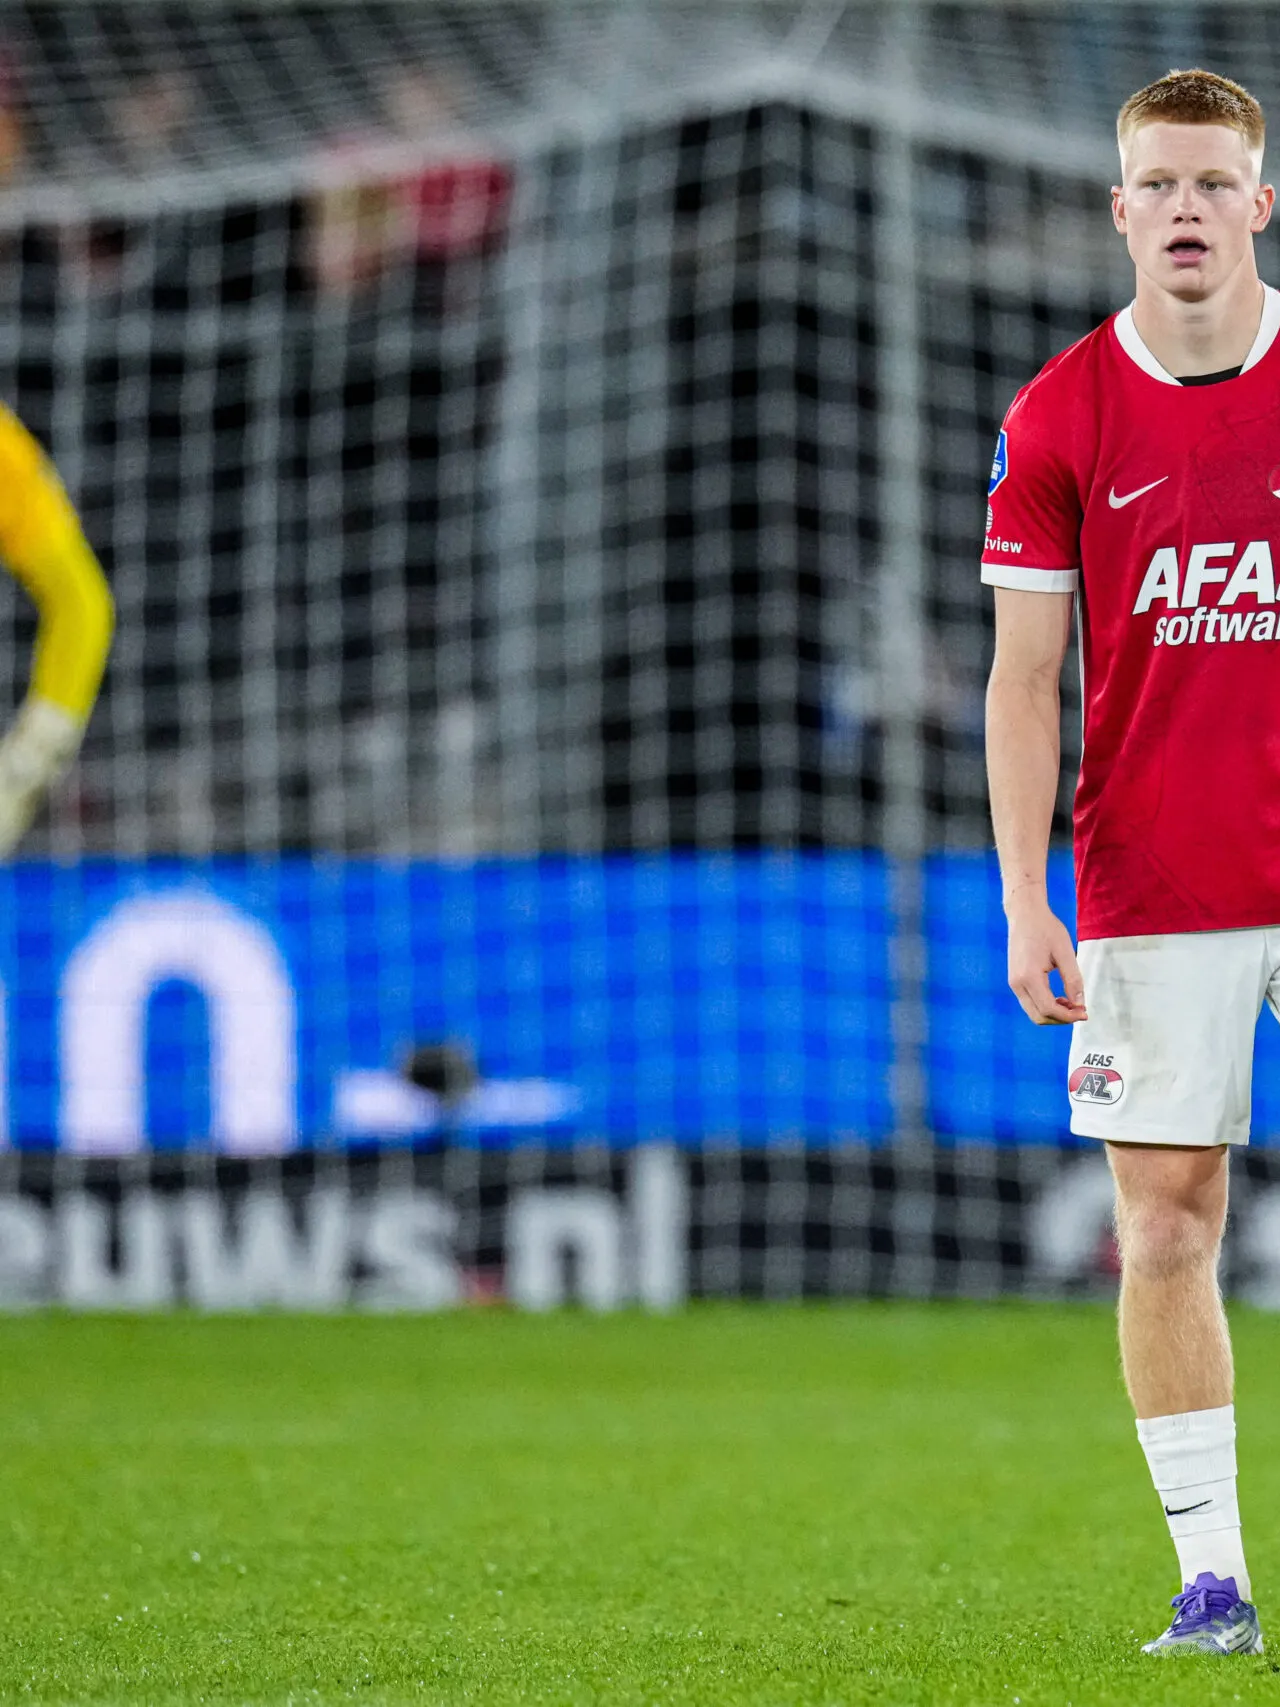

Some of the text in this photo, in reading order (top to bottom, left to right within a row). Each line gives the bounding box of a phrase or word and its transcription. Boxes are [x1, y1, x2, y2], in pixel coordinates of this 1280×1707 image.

[0, 884, 297, 1157] n
[1083, 1053, 1114, 1067] AFAS
[1076, 1073, 1112, 1100] AZ
